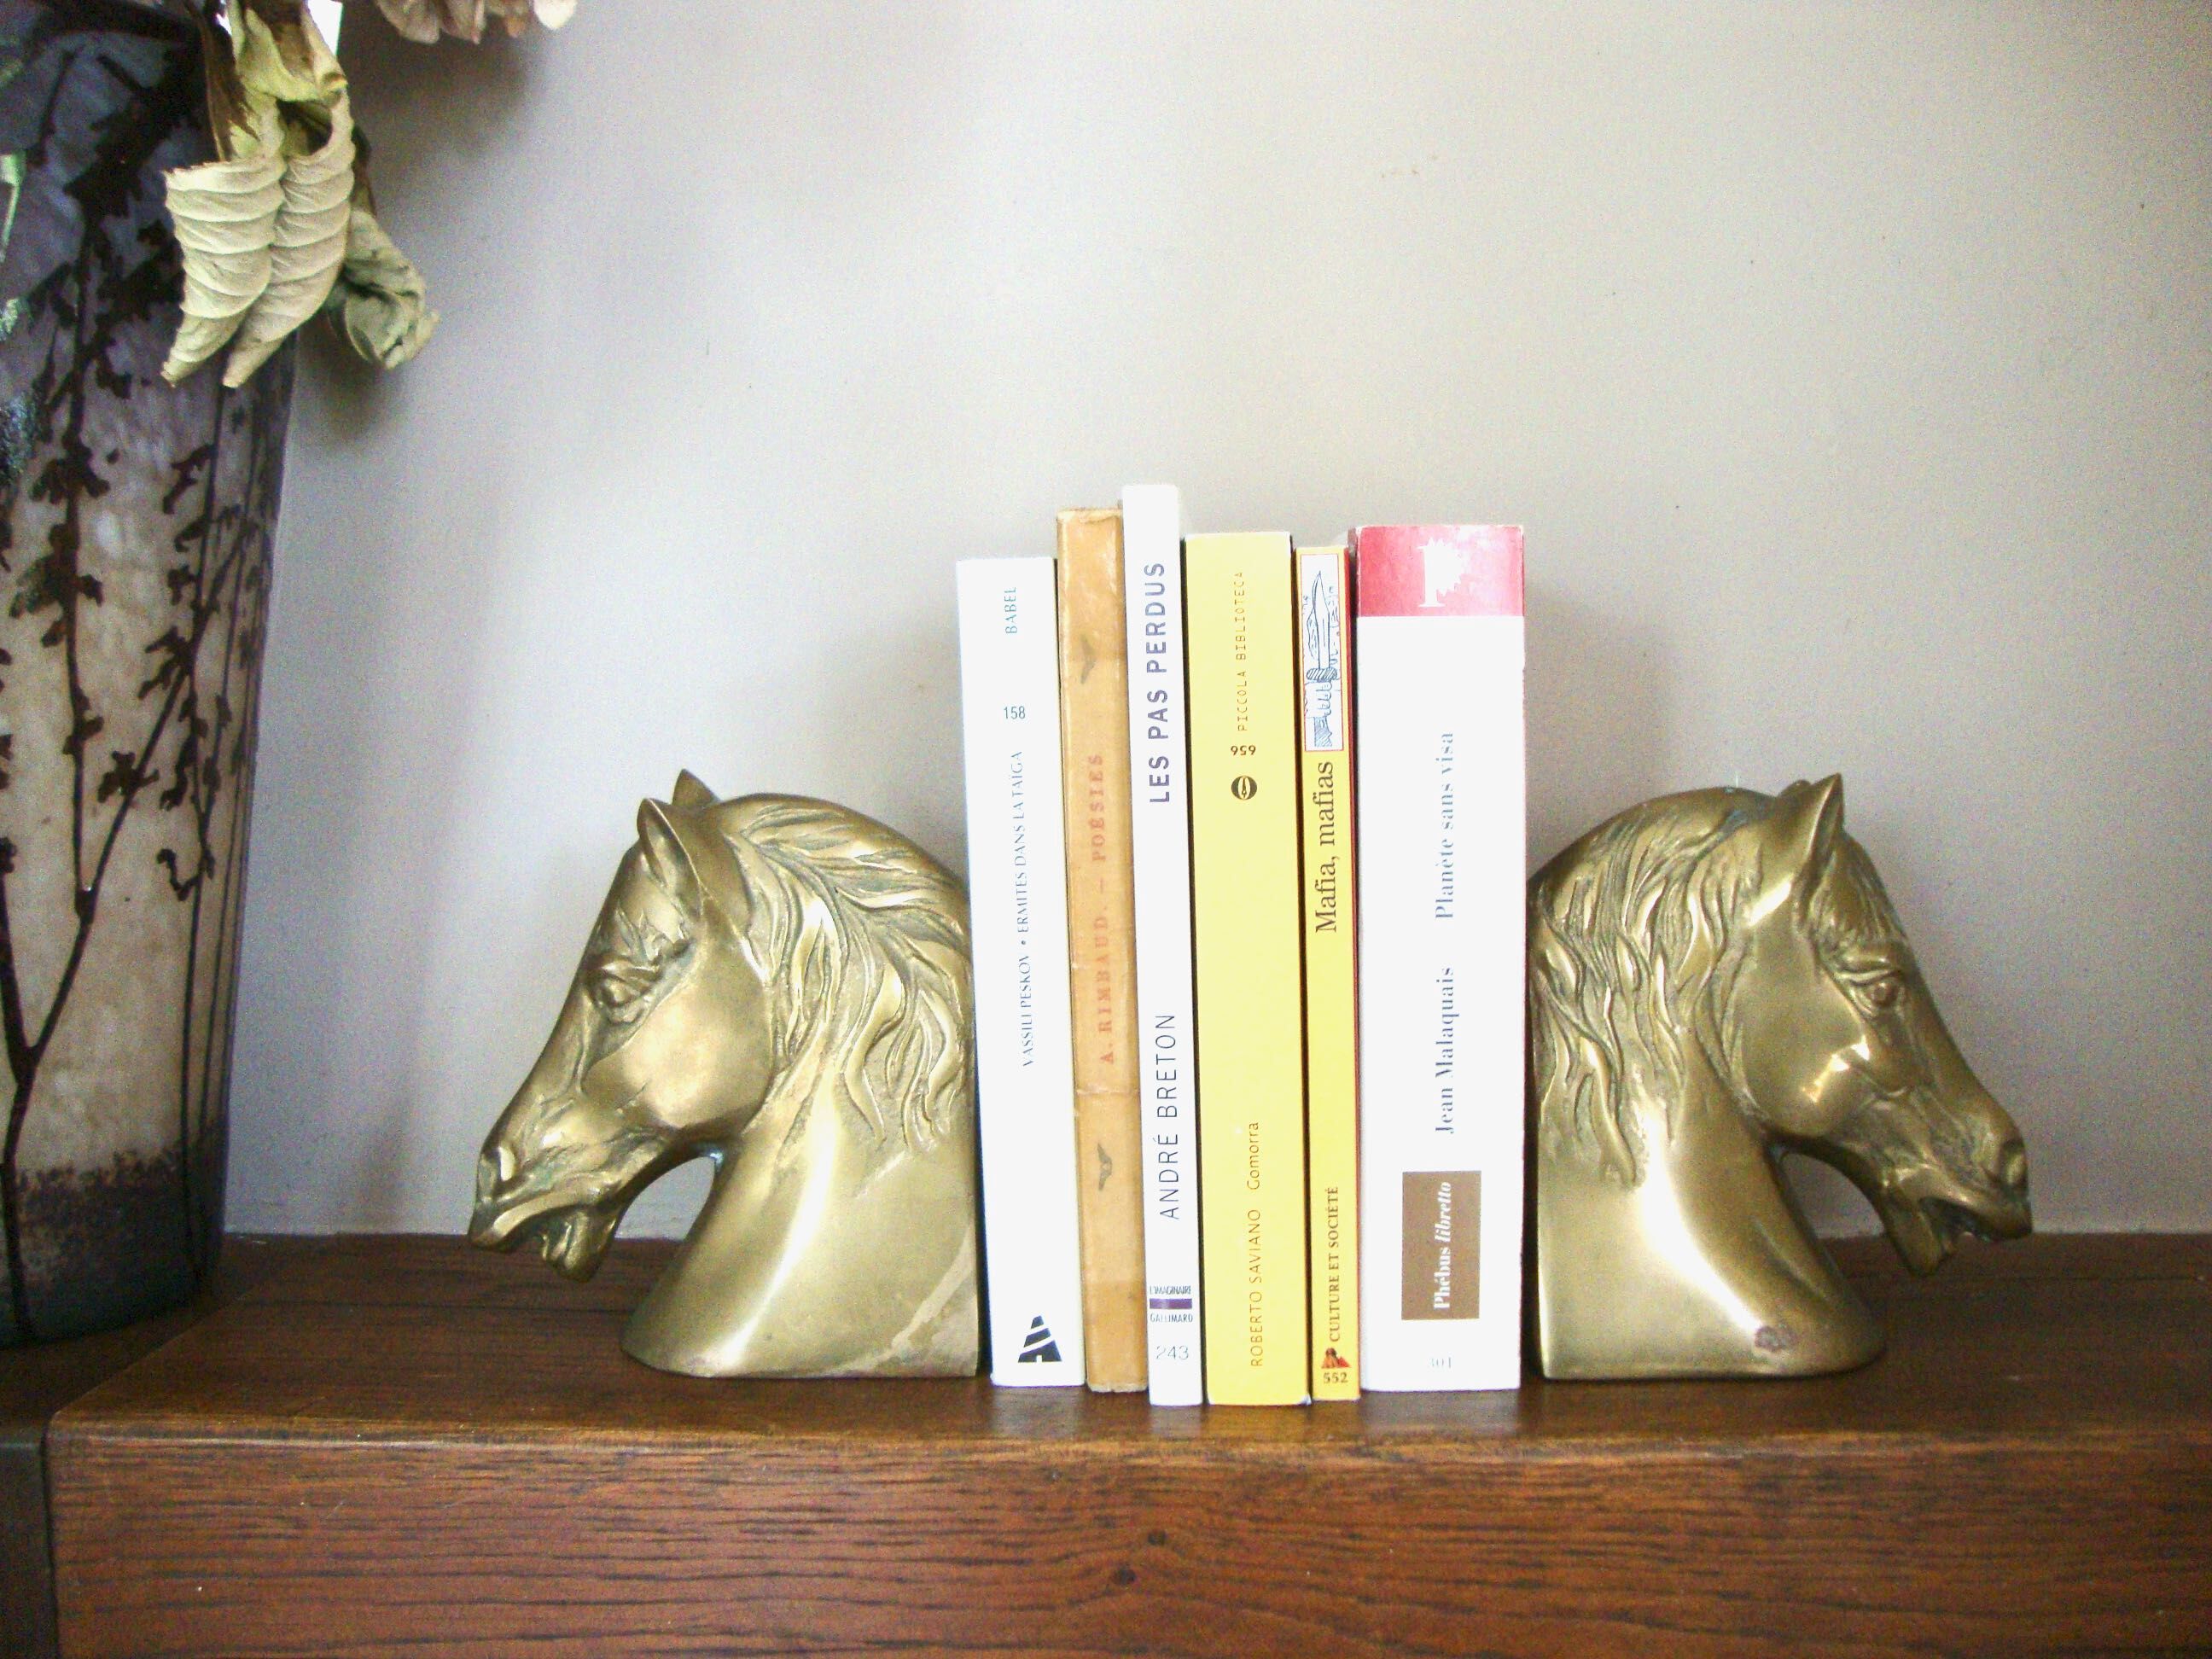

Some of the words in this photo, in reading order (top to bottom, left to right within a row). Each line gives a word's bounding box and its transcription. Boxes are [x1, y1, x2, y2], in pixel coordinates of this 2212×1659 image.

[1004, 586, 1018, 634] BABEL
[1144, 563, 1167, 673] PERDUS
[1233, 570, 1247, 661] BIBLIOTECA
[1003, 705, 1026, 720] 158
[1146, 690, 1169, 740] PAS
[1237, 671, 1249, 731] PICCOLA
[1010, 751, 1024, 797] TAÏGA
[1148, 755, 1170, 803] LES
[1435, 733, 1453, 775] visa
[1011, 795, 1025, 819] LA
[1312, 761, 1336, 847] mafias
[1441, 783, 1454, 830] sans
[1014, 824, 1027, 866] DANS
[1016, 872, 1029, 933] ERMITES
[1314, 856, 1340, 934] Mafia,
[1435, 839, 1454, 918] Planète
[1018, 955, 1032, 1008] PESKOV
[1021, 1014, 1033, 1067] VASSILI
[1435, 967, 1460, 1078] Malaquais
[1155, 1016, 1178, 1118] BRETON
[1435, 1087, 1455, 1134] Jean
[1150, 1132, 1179, 1220] ANDRÉ
[1246, 1121, 1260, 1190] Gomorra
[1324, 1186, 1339, 1249] SOCIÉTÉ
[1434, 1181, 1452, 1243] libretto
[1247, 1209, 1262, 1284] SAVIANO
[1328, 1253, 1339, 1271] ET
[1433, 1246, 1452, 1309] Phébus
[1249, 1291, 1264, 1367] ROBERTO
[1328, 1274, 1341, 1342] CULTURE
[1155, 1345, 1189, 1359] 243
[1323, 1371, 1348, 1384] 552
